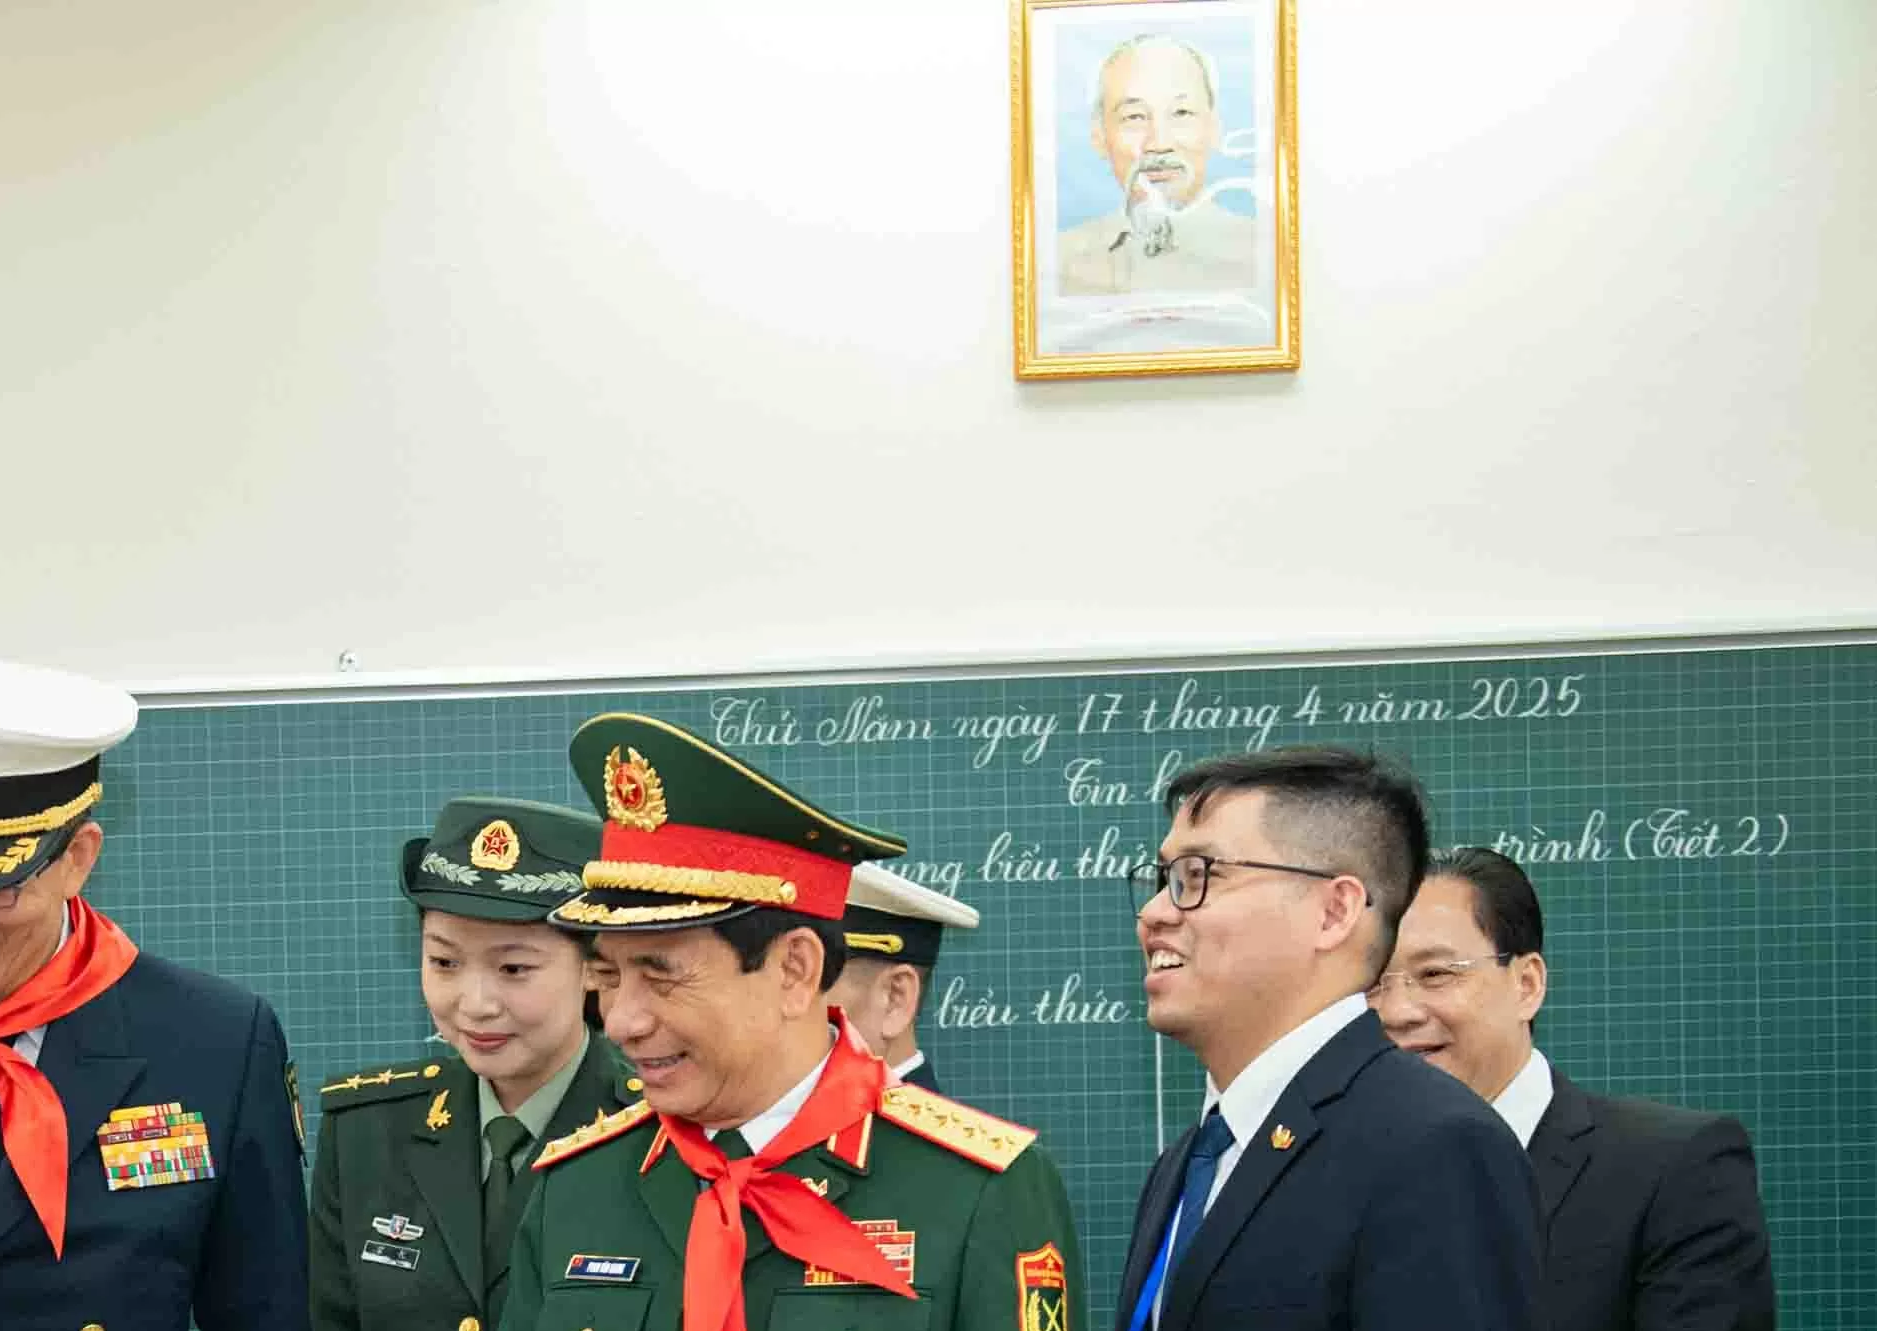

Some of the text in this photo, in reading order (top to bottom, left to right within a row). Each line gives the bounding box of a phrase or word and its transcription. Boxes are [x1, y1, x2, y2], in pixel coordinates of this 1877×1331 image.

[709, 672, 1586, 770] Thứ Năm ngày 17 tháng 4 năm 2025
[1064, 757, 1133, 807] Tin
[977, 830, 1063, 883] biểu
[1490, 808, 1613, 862] trình
[1730, 813, 1790, 858] 2)
[934, 974, 1020, 1030] biểu
[1030, 972, 1132, 1026] thức
